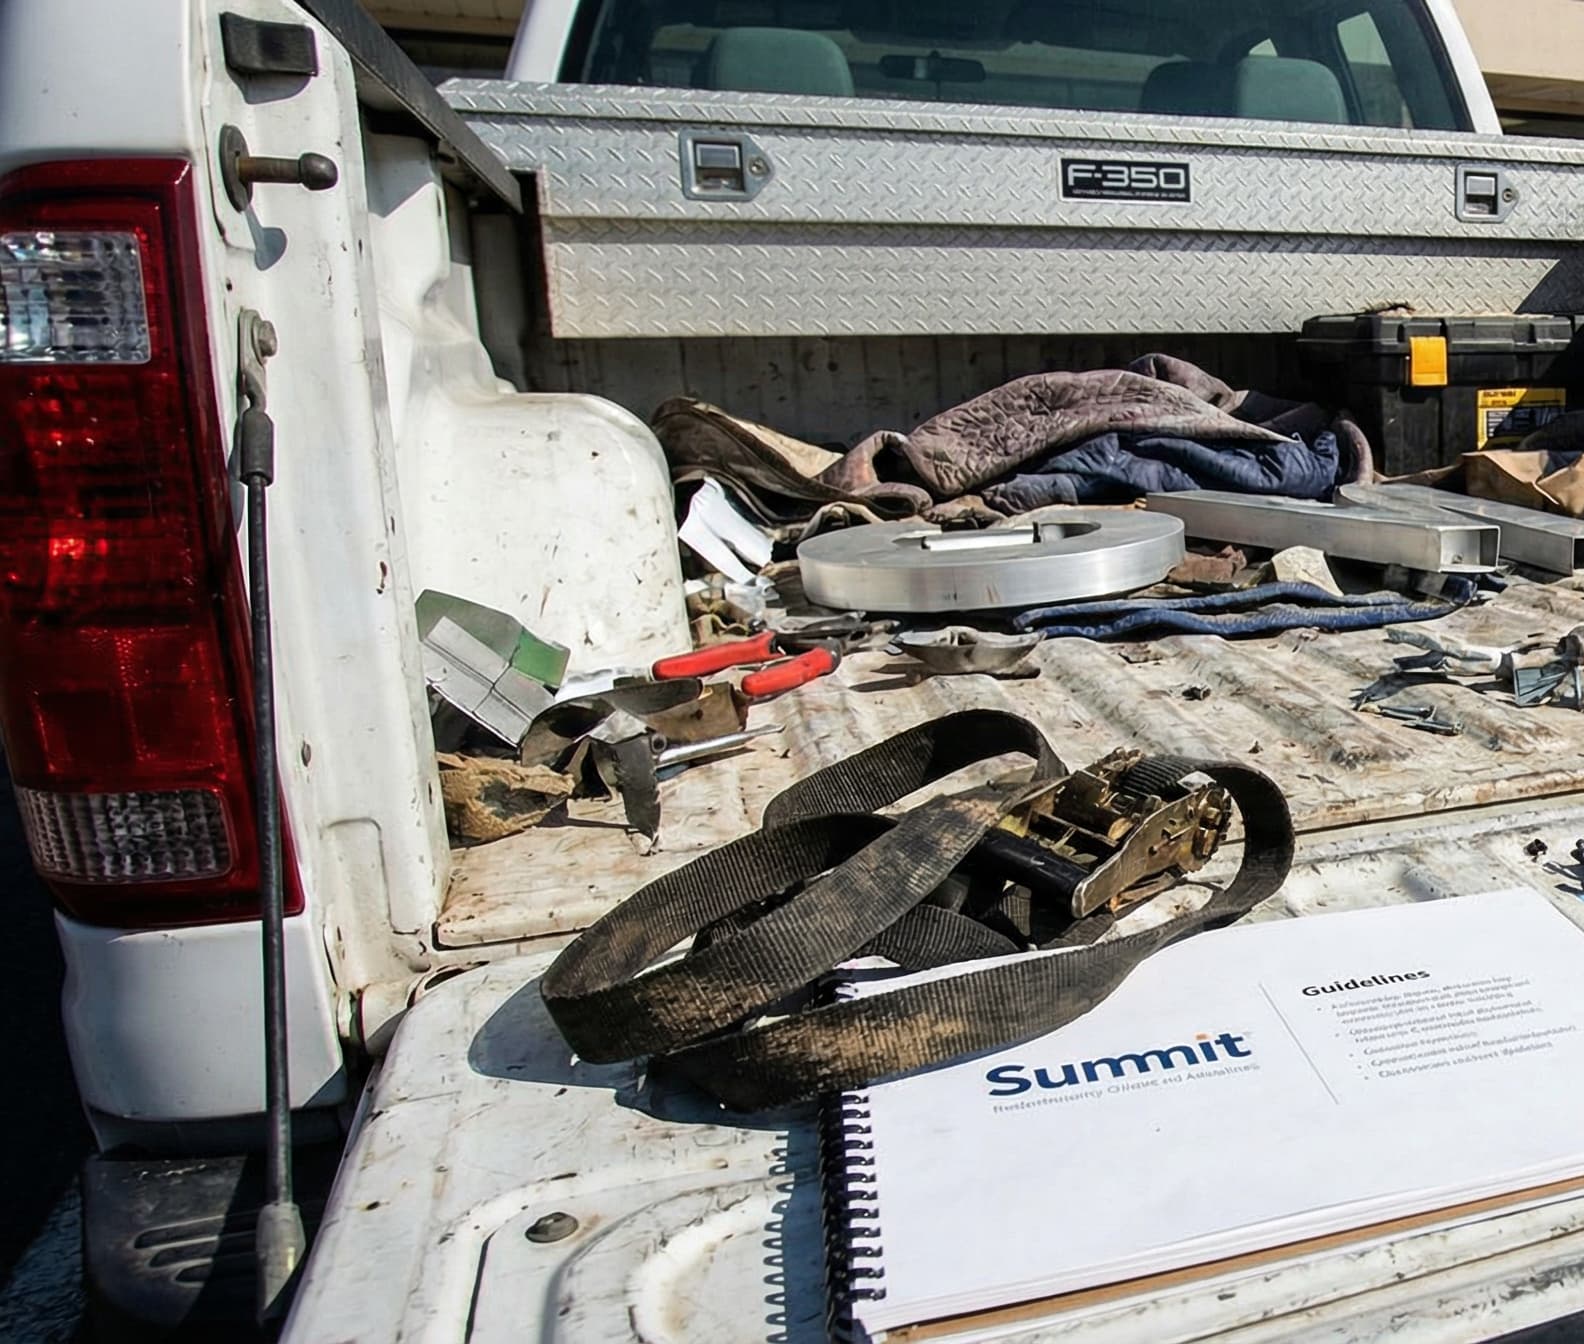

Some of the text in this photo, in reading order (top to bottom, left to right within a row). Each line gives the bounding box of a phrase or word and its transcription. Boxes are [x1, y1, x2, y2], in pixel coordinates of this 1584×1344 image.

[1067, 164, 1186, 189] F-350
[1301, 968, 1431, 997] Guidelines
[985, 1032, 1252, 1097] Summit
